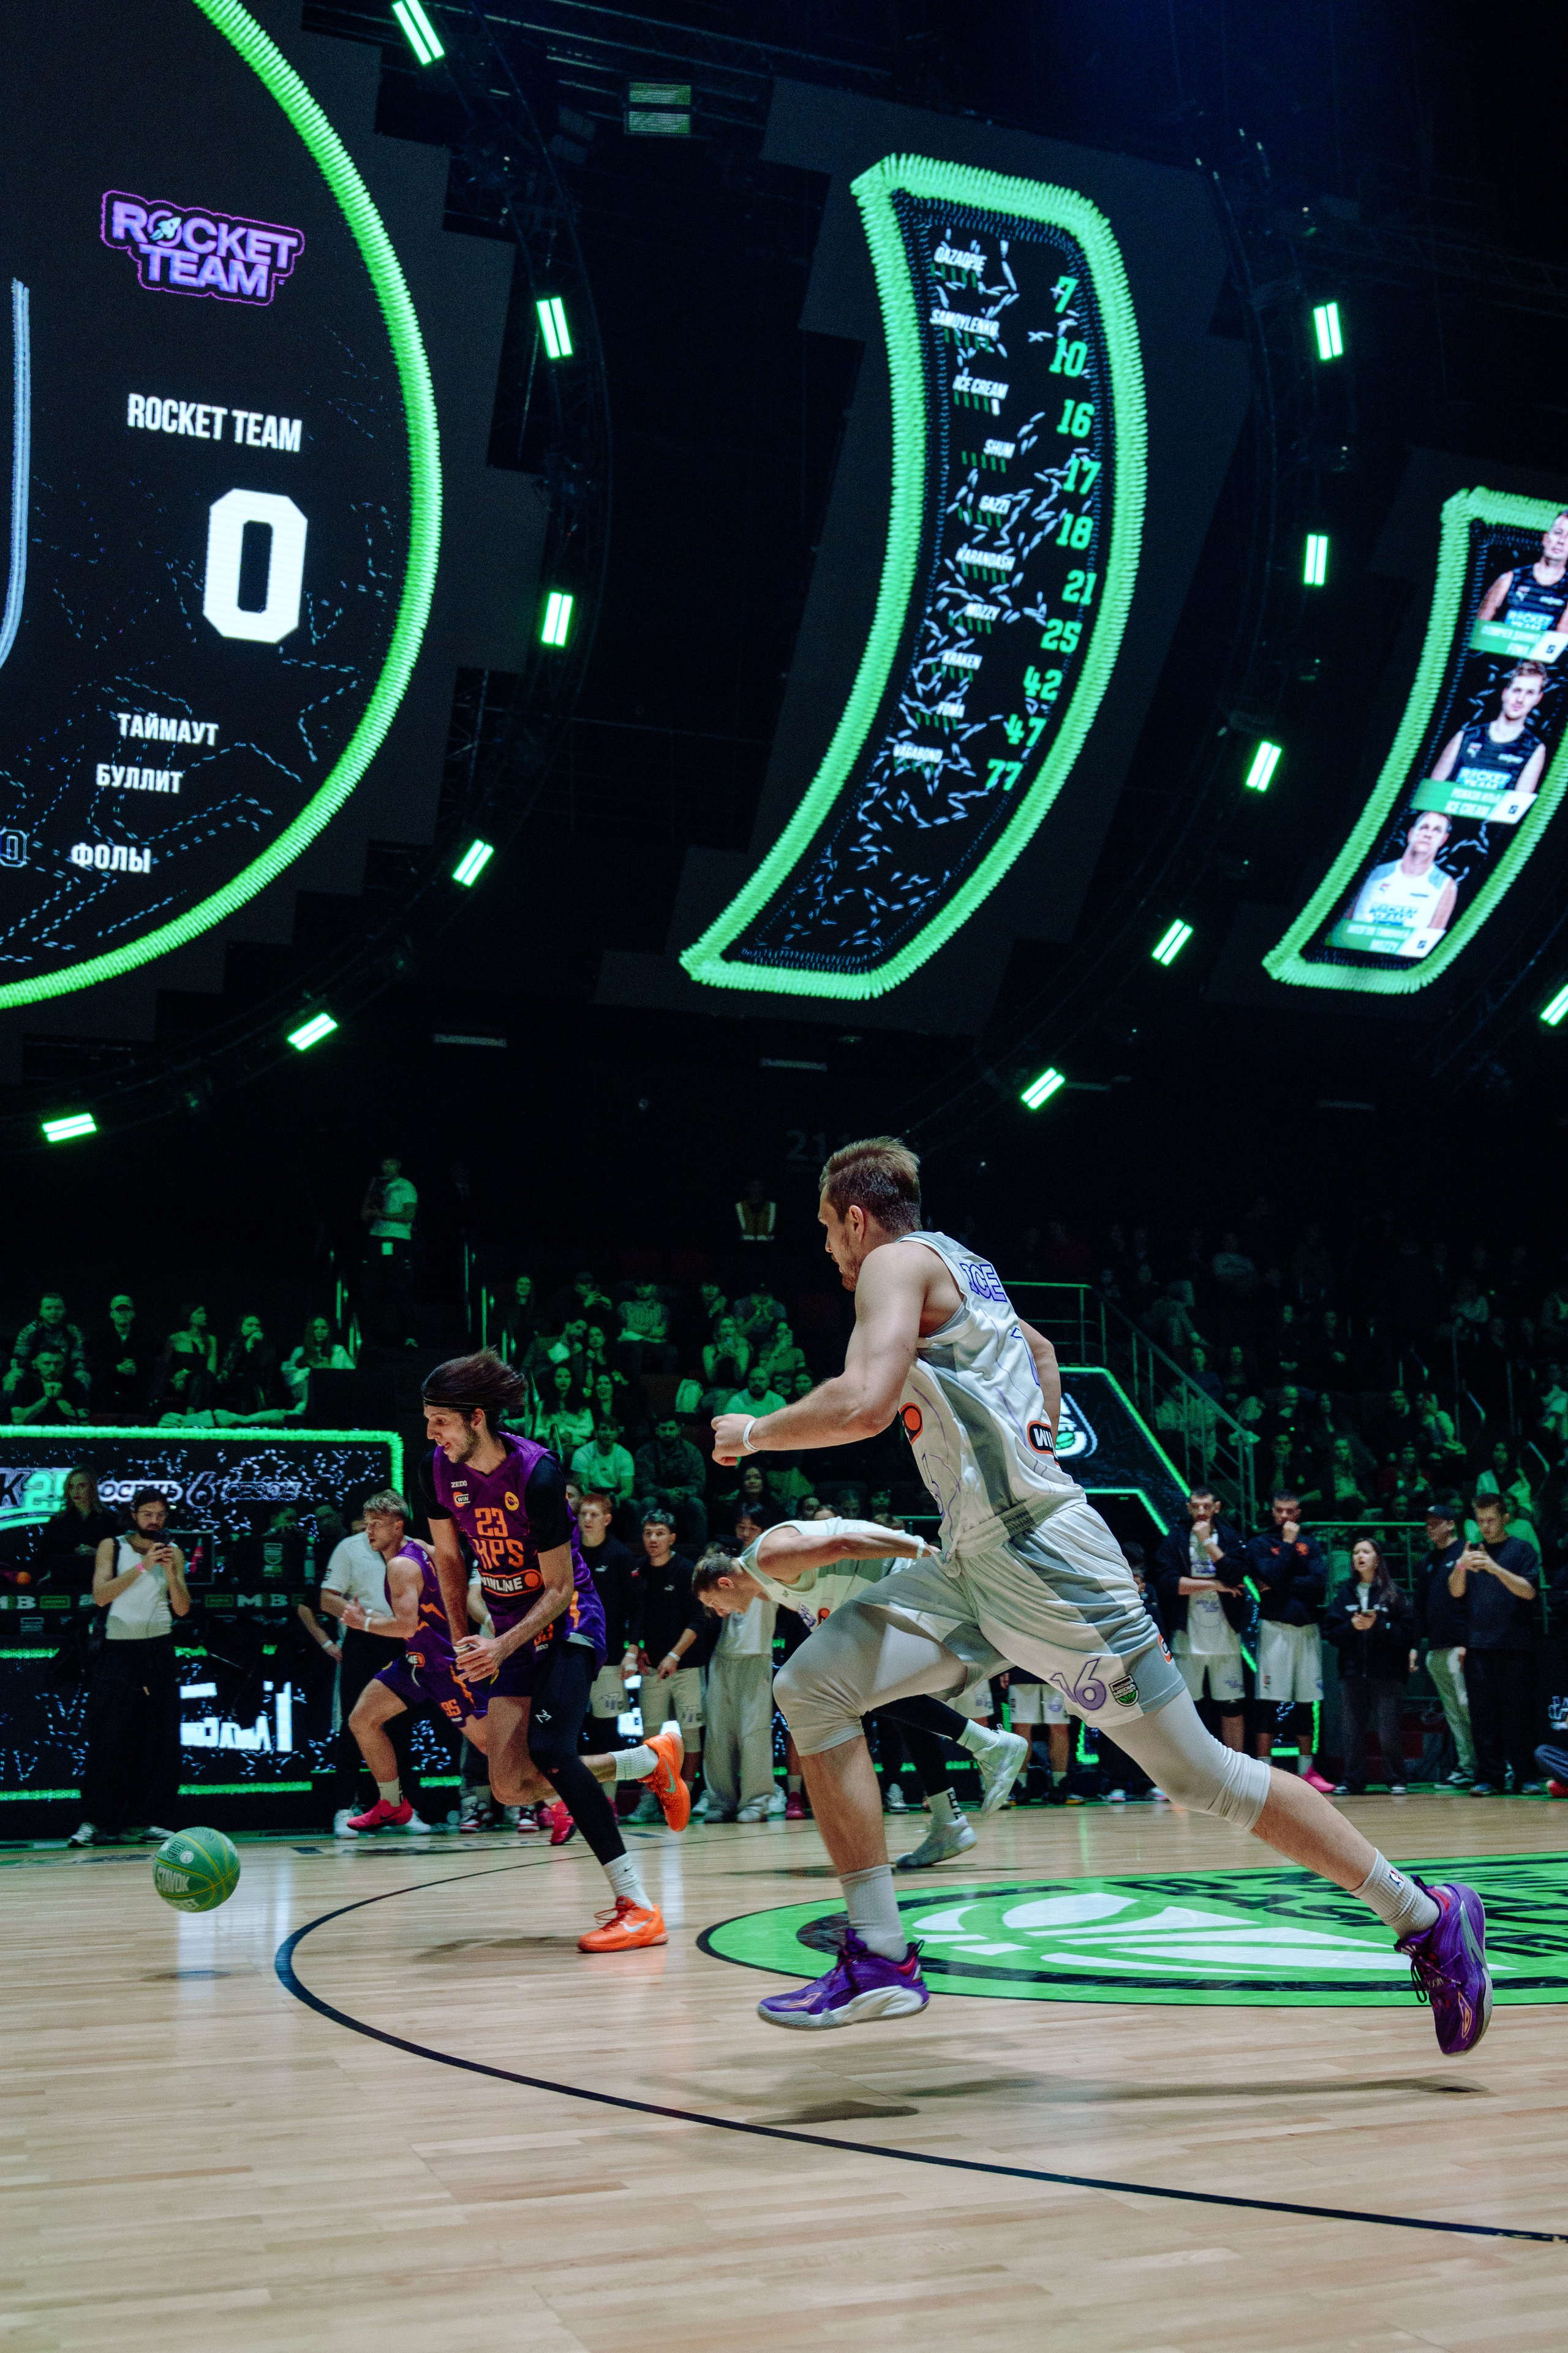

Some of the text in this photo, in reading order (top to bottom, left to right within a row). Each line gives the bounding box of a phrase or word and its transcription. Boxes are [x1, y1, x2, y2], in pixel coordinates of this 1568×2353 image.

[112, 200, 298, 268] ROCKET
[140, 243, 270, 297] TEAM
[1055, 275, 1079, 314] 7
[929, 308, 1000, 338] SAMOYLENKO
[1049, 337, 1088, 378] 10
[952, 375, 1009, 399] ICE CREAM
[127, 393, 303, 452] ROCKET TEAM
[1057, 399, 1095, 439] 16
[983, 439, 1016, 459] SHUM
[1063, 458, 1102, 495] 17
[1055, 513, 1094, 550] 18
[203, 488, 308, 644] 0
[956, 548, 1016, 571] KARANDASH
[1061, 569, 1097, 606] 21
[1041, 619, 1083, 654] 25
[941, 651, 982, 670] KRAKEN
[1023, 666, 1063, 700] 42
[118, 712, 219, 746] ТАЙМАУТ
[1006, 714, 1047, 747] 47
[894, 744, 943, 763] VAGABOND
[96, 763, 184, 793] БУЛЛИТ
[986, 758, 1023, 791] 77
[70, 842, 151, 874] ФОЛЫ
[959, 1263, 1008, 1303] ICE
[475, 1507, 508, 1538] 23
[1050, 1658, 1107, 1710] 16
